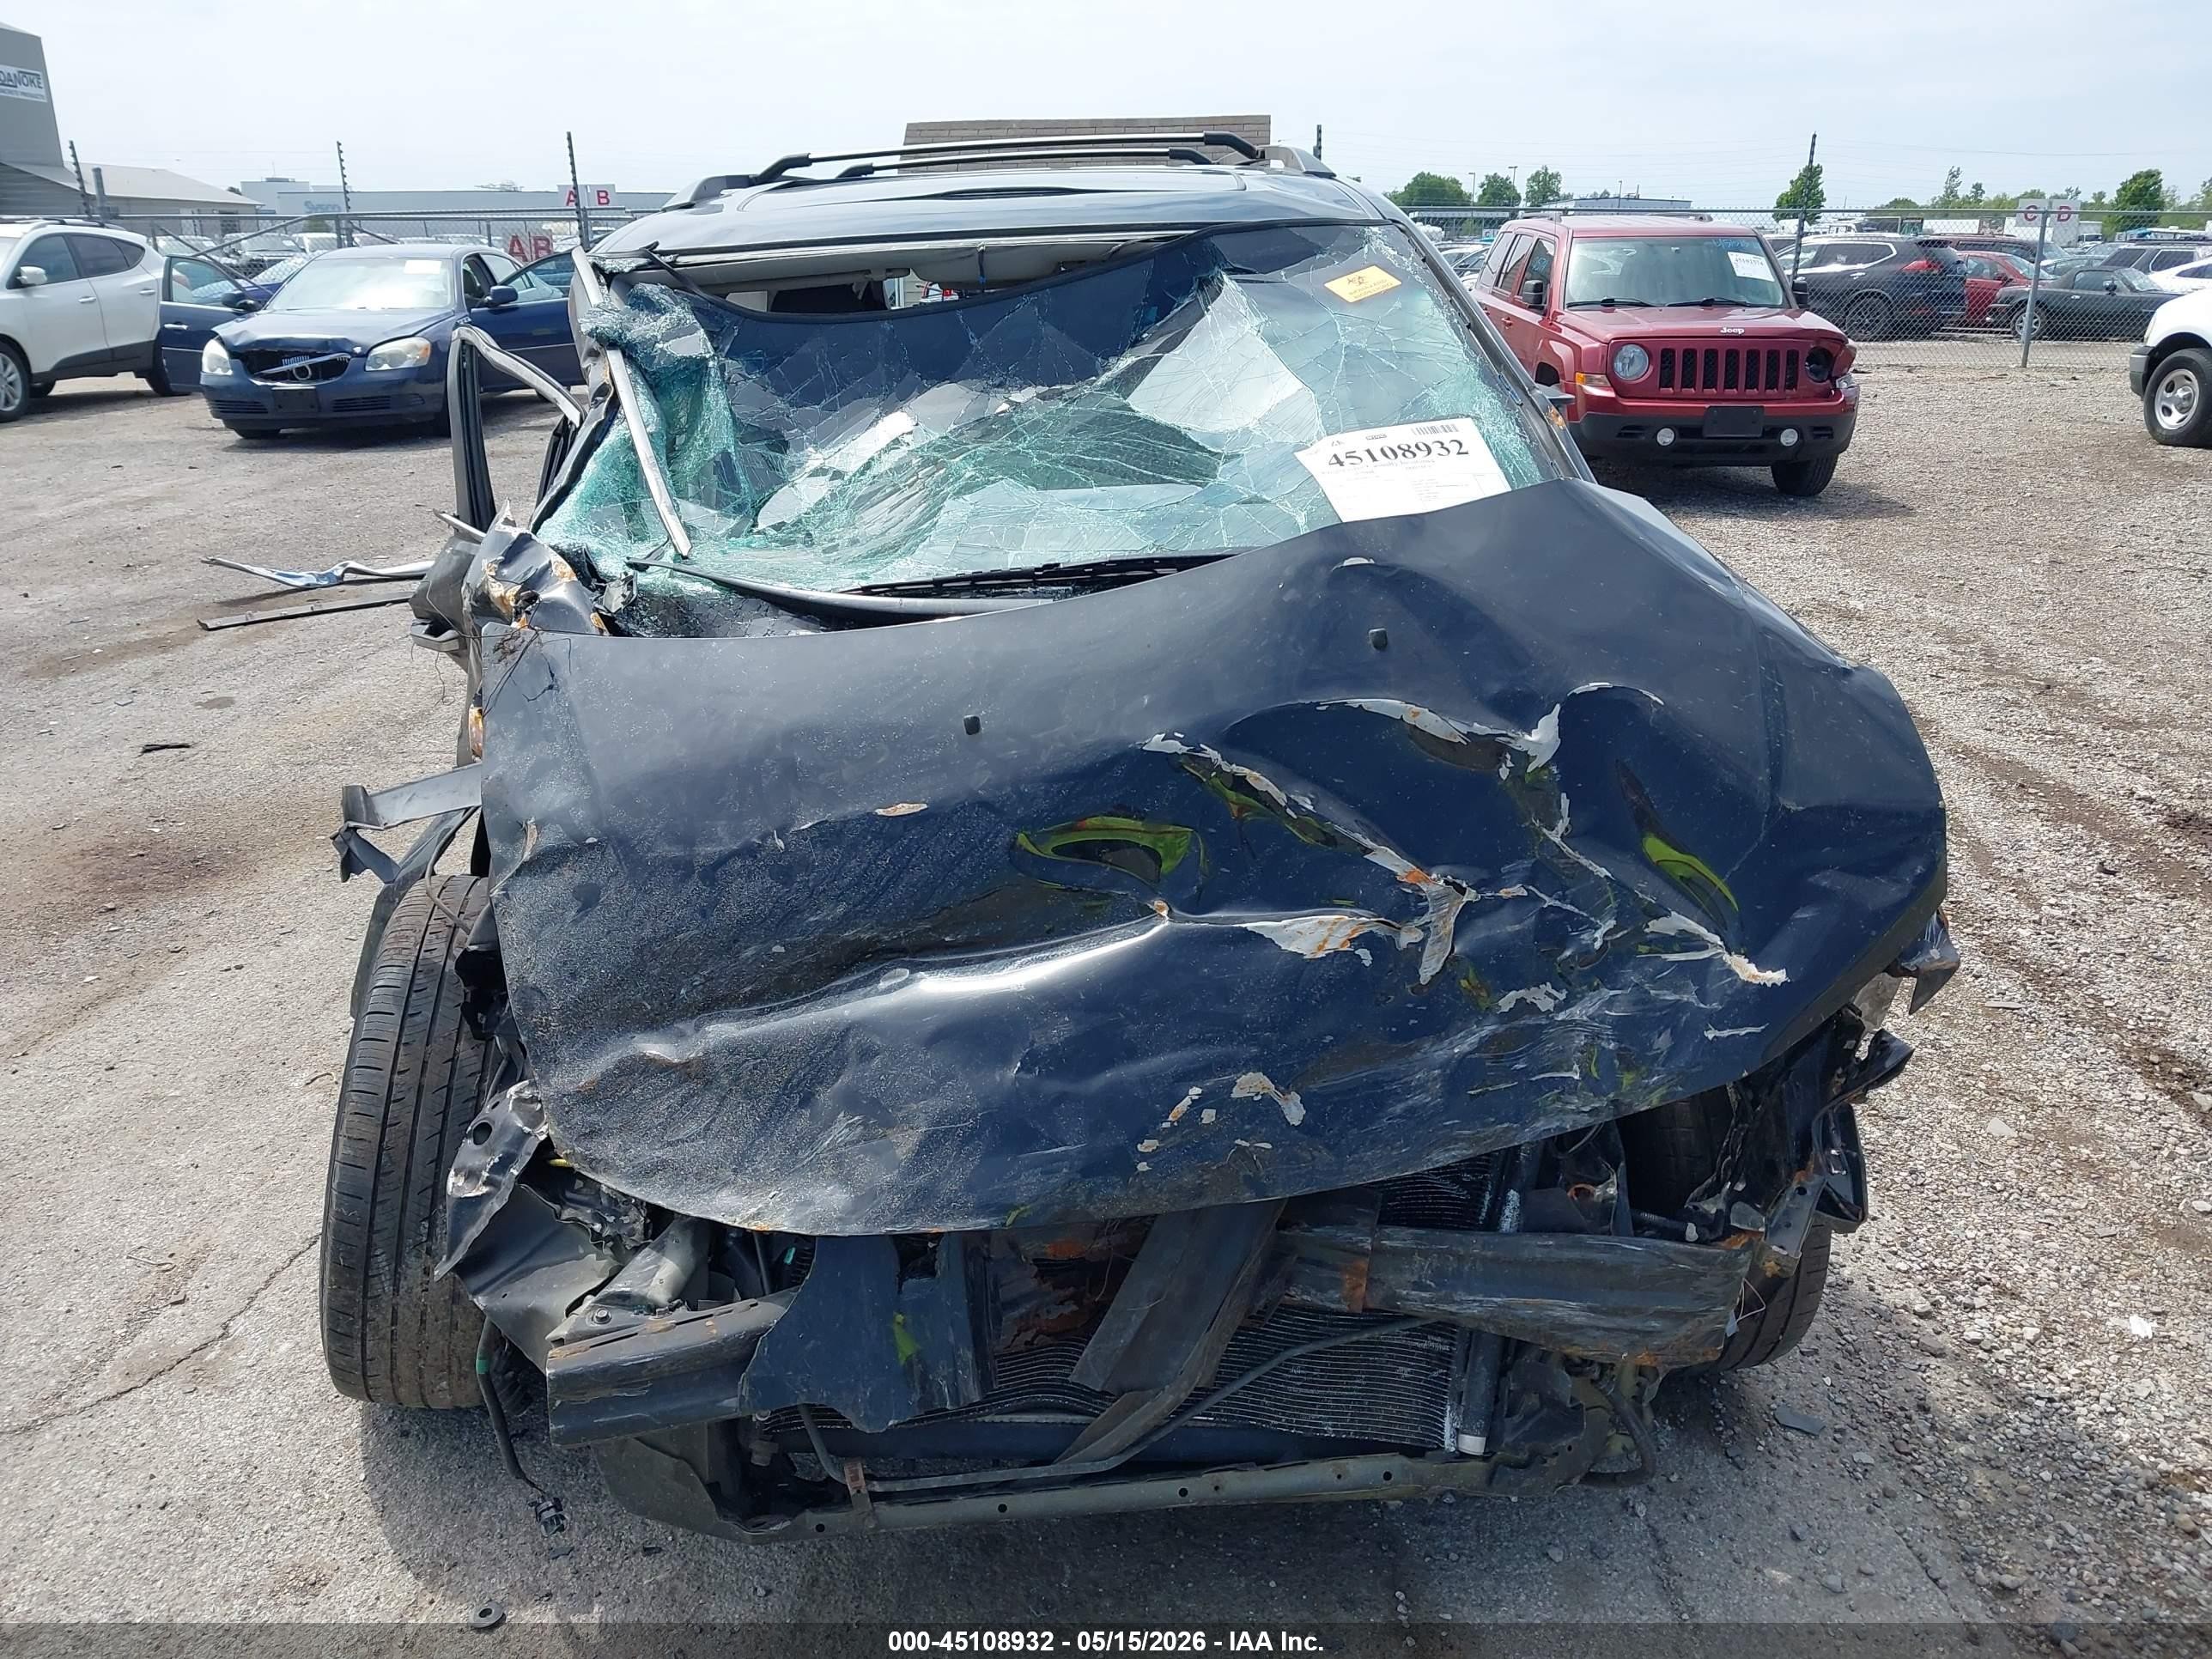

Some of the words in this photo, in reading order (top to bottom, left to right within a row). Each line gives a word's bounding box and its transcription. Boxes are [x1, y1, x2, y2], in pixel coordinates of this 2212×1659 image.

[566, 190, 577, 206] A
[597, 190, 610, 205] B
[2024, 205, 2038, 222] C
[2057, 205, 2071, 222] D
[508, 234, 528, 262] A
[1720, 326, 1745, 335] Jeep
[1328, 439, 1469, 467] 45108932
